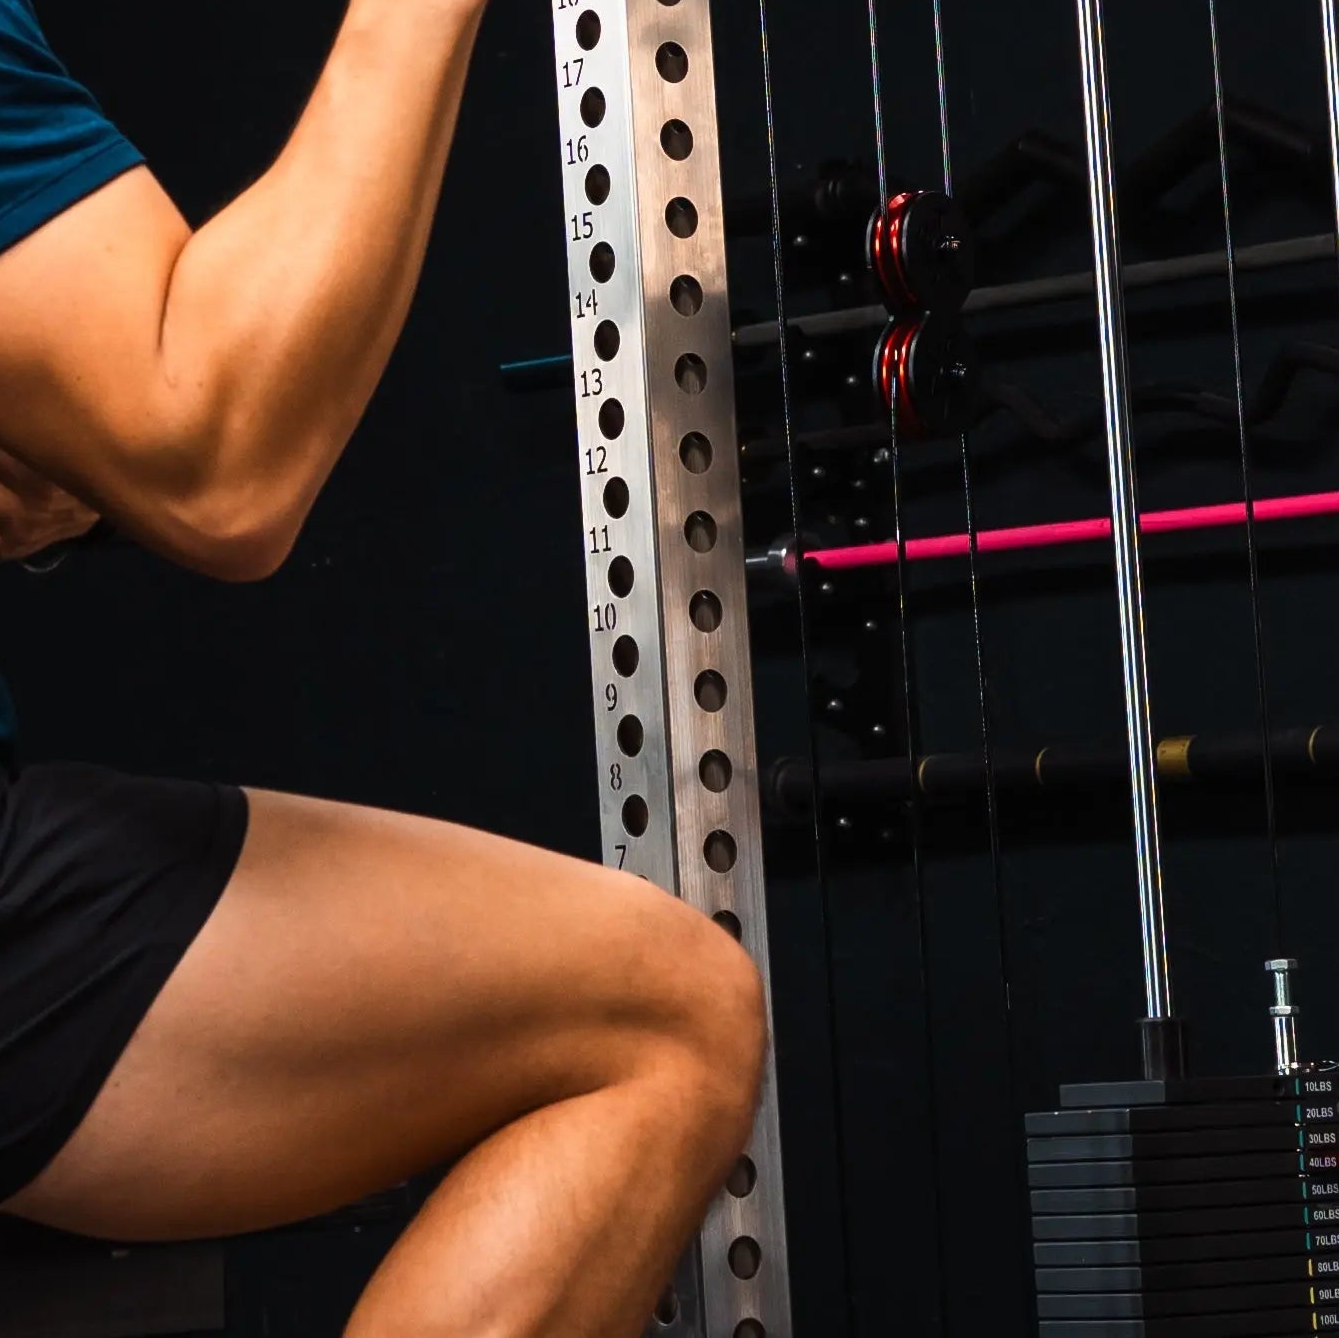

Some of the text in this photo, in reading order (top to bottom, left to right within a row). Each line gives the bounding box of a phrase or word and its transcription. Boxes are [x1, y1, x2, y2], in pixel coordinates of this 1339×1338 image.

[562, 58, 584, 88] 17
[565, 135, 589, 166] 16
[571, 211, 594, 242] 15
[575, 289, 598, 320] 14
[580, 368, 603, 398] 13
[585, 446, 608, 476] 12
[589, 524, 612, 555] 11
[593, 602, 617, 632] 10
[605, 683, 617, 712] 9
[610, 762, 622, 791] 8
[615, 845, 627, 870] 7
[1305, 1081, 1332, 1092] 10LBS
[1306, 1106, 1334, 1119] 20LBS
[1309, 1132, 1336, 1145] 30LBS
[1309, 1156, 1337, 1169] 40LBS
[1311, 1183, 1339, 1196] 50LBS
